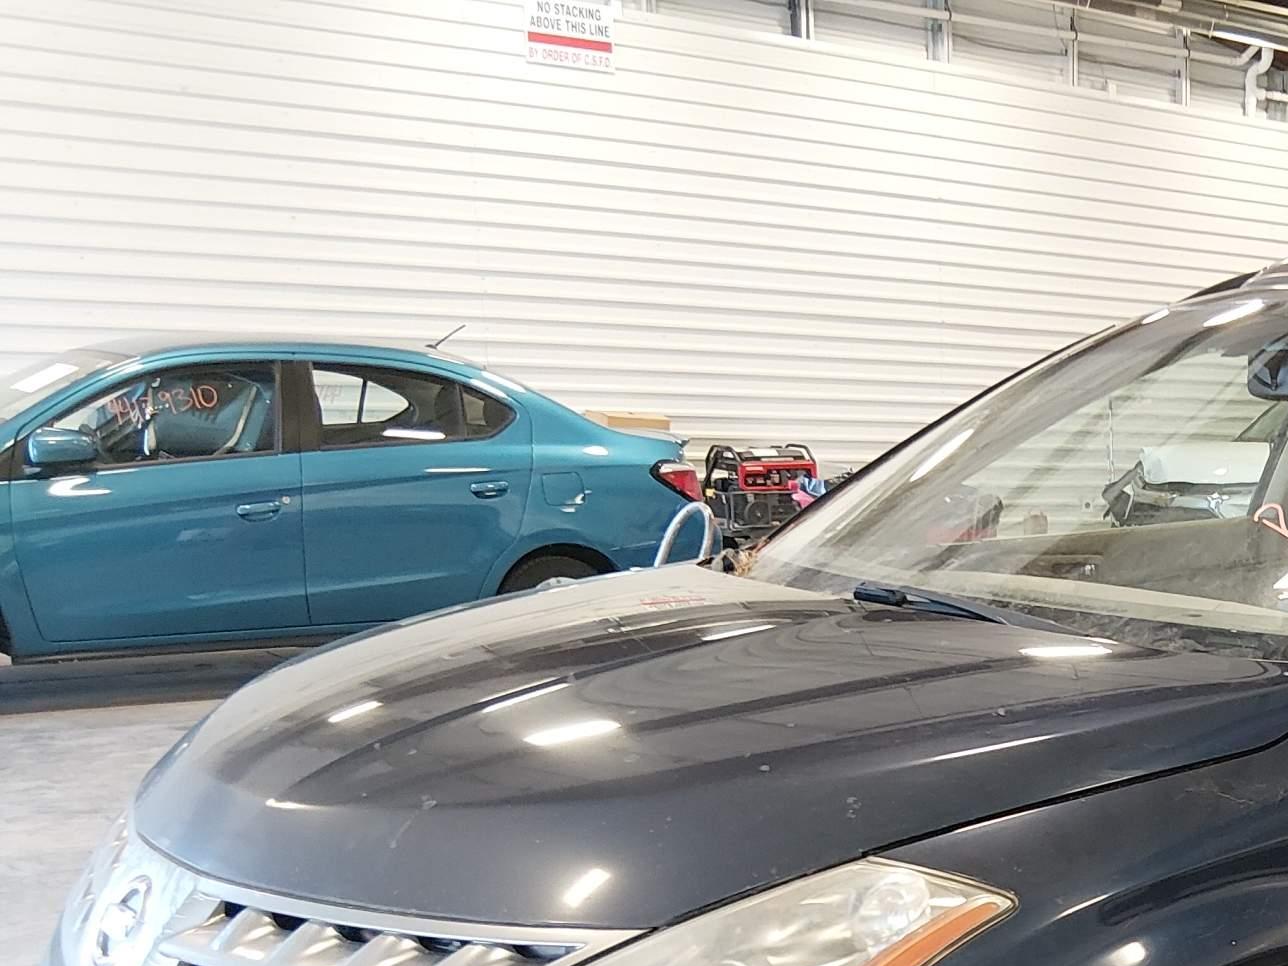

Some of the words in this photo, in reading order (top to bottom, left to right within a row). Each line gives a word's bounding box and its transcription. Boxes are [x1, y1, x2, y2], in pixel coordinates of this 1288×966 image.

[537, 1, 551, 14] NO
[554, 3, 601, 21] STACKING
[530, 15, 562, 31] ABOVE
[565, 20, 586, 34] THIS
[589, 24, 611, 38] LINE
[528, 46, 539, 58] BY
[542, 48, 569, 62] ORDER
[571, 52, 582, 64] OF
